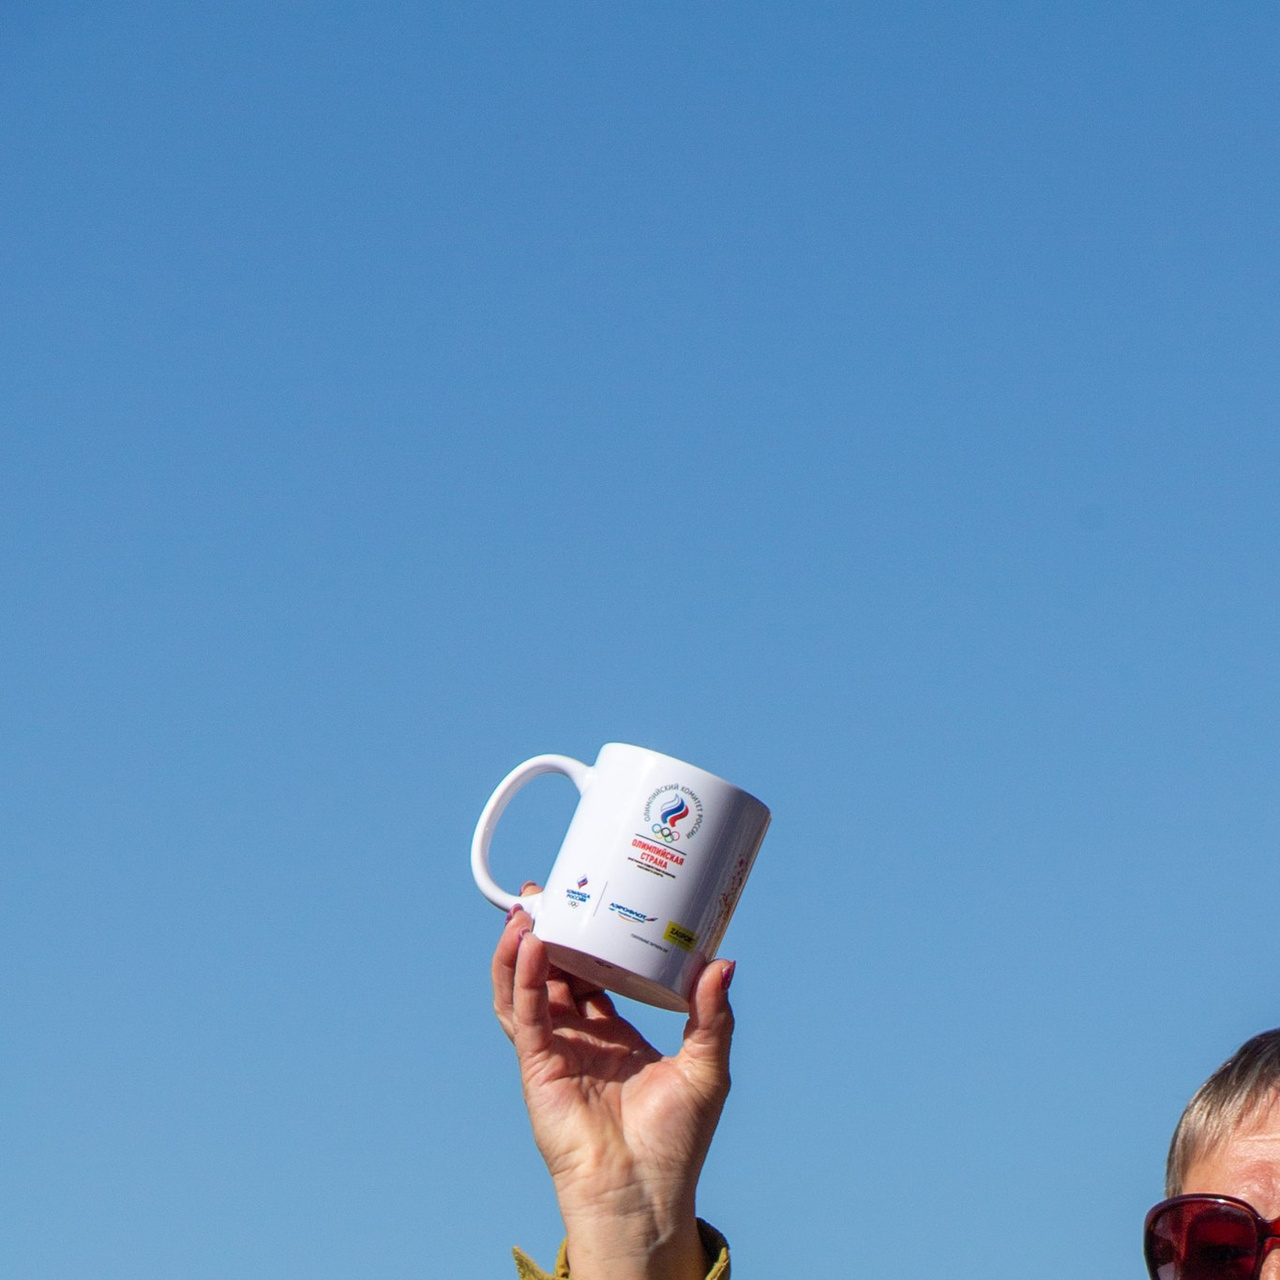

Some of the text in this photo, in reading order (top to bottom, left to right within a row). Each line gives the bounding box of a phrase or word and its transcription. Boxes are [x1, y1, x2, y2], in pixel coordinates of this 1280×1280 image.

[643, 783, 704, 840] ОЛИМПИЙСКИЙ КОМИТЕТ РОССИИ
[631, 839, 685, 866] ОЛИМПИЙСКАЯ
[640, 852, 668, 869] СТРАНА
